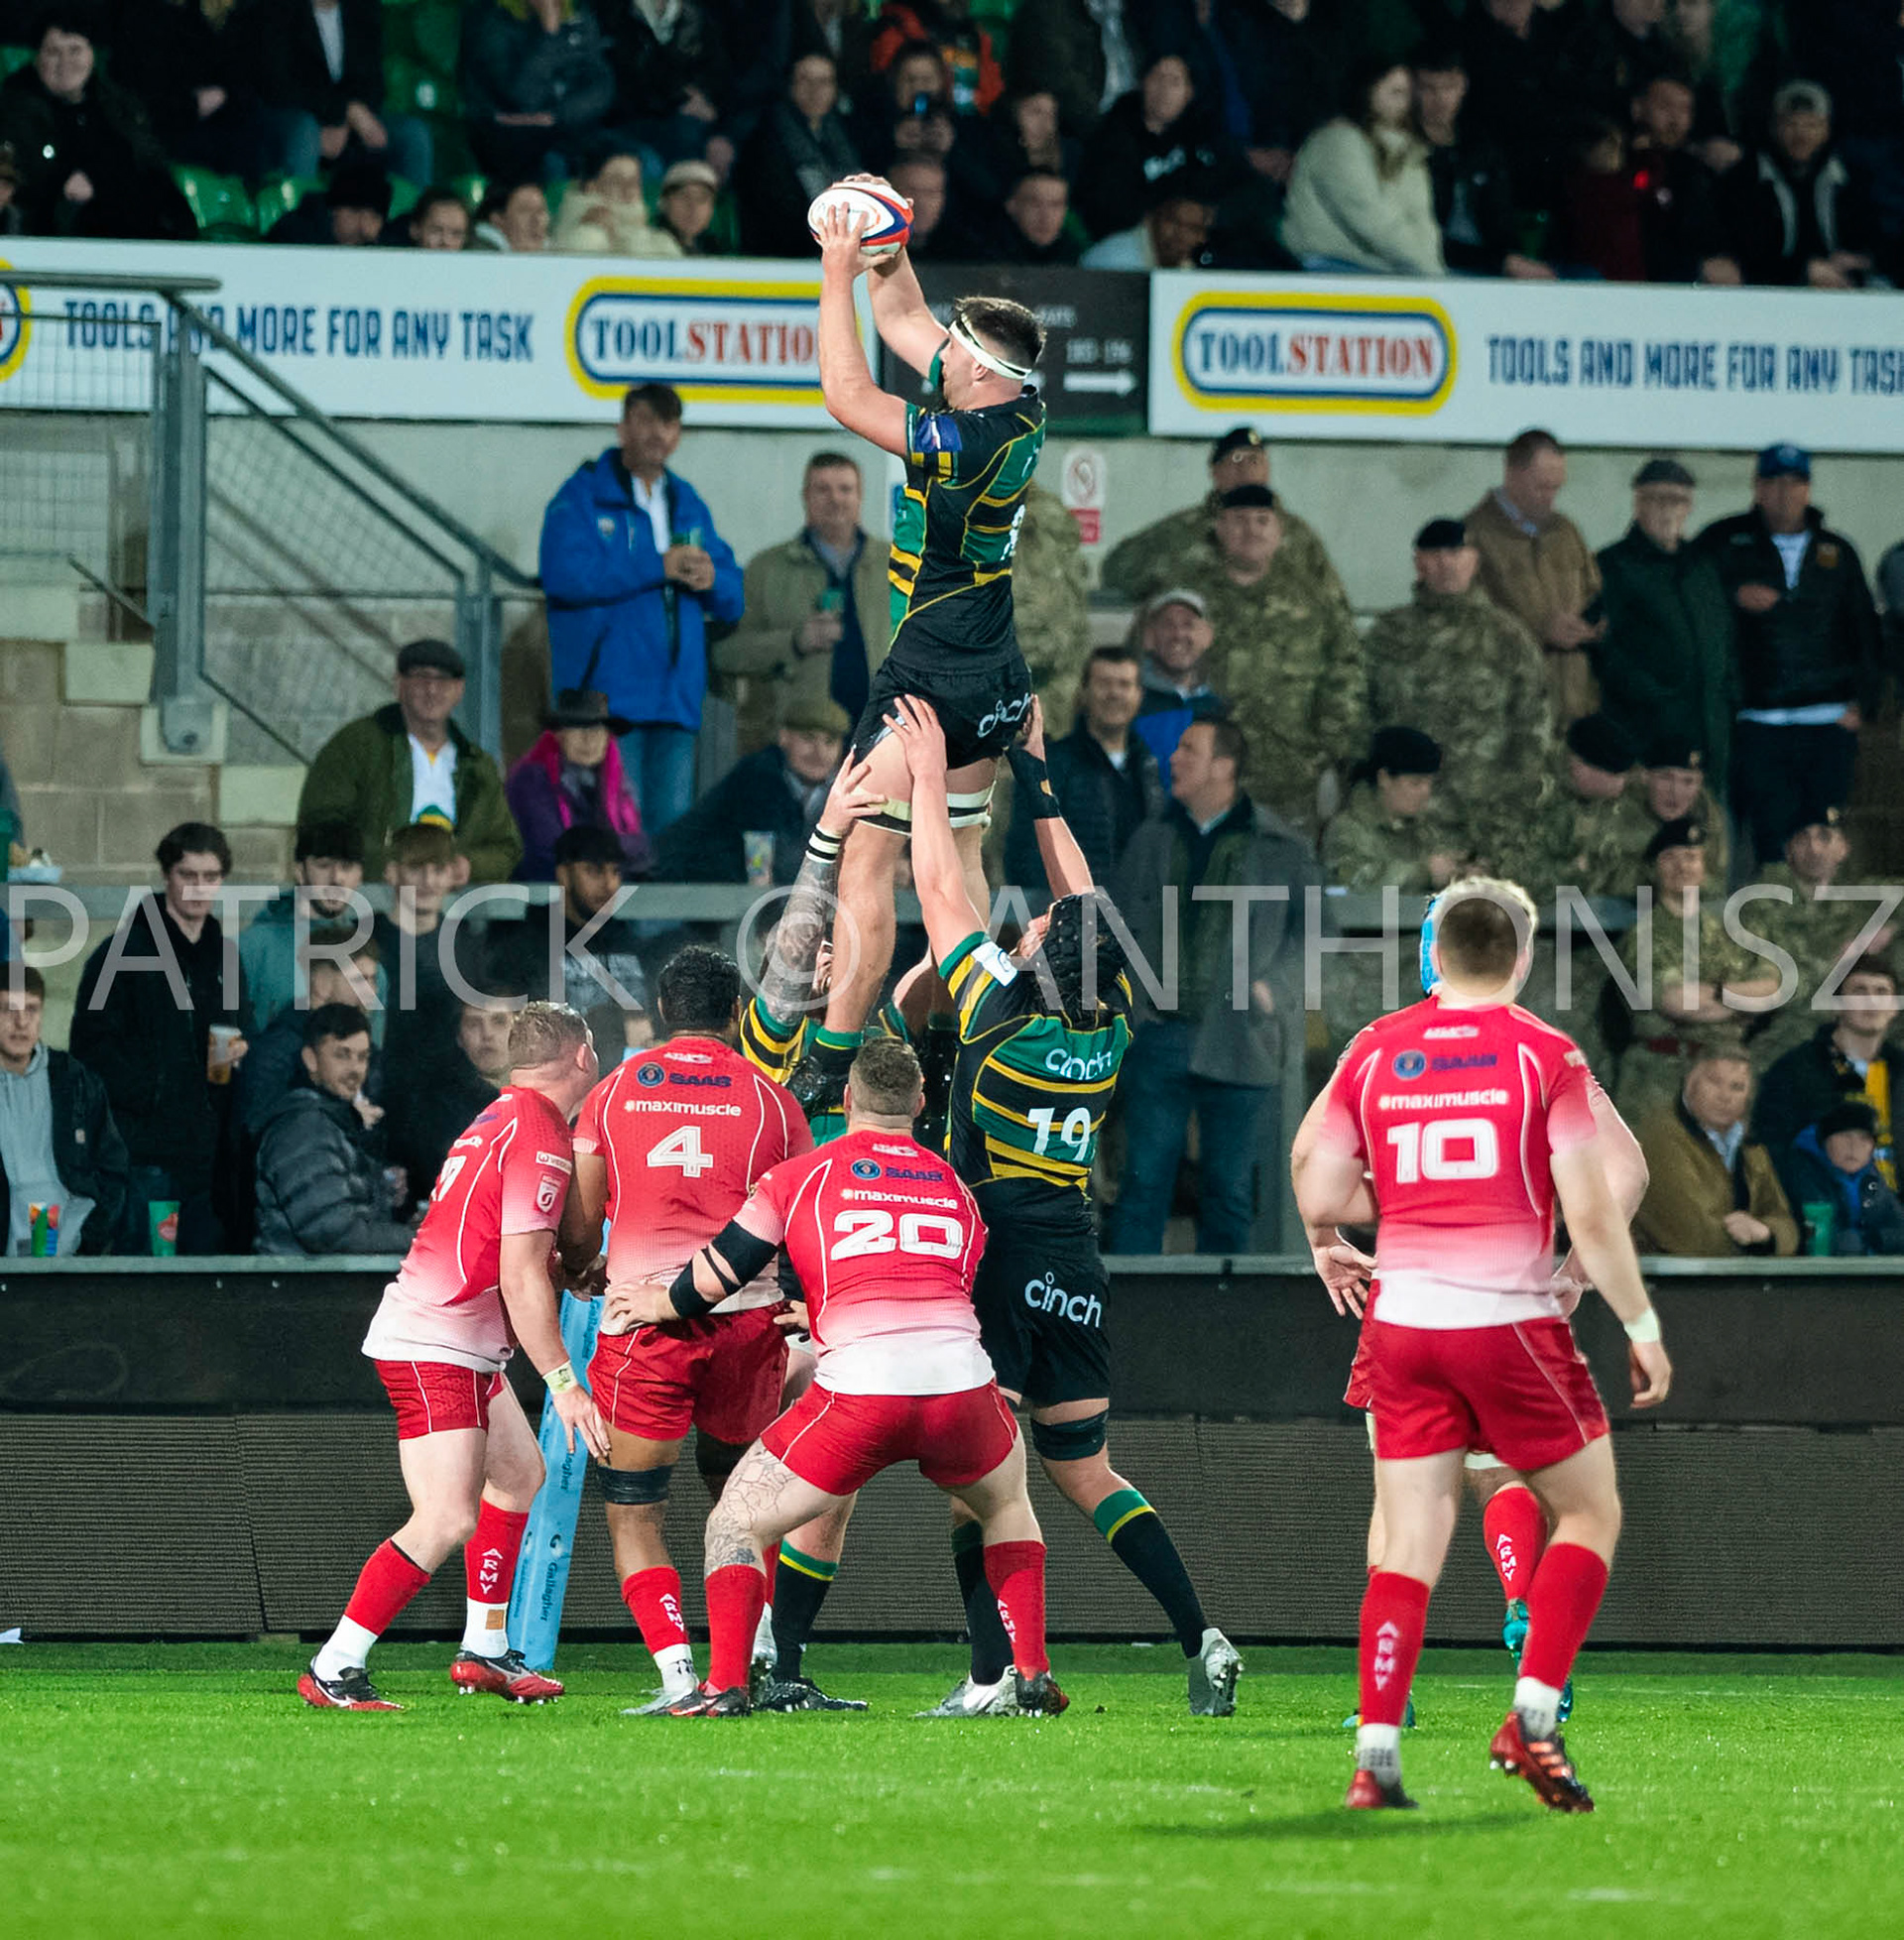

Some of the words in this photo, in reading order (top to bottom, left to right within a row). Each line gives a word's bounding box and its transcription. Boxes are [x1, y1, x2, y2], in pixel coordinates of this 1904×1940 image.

[63, 300, 155, 349] TOOLS
[238, 304, 317, 356] MORE
[327, 306, 382, 358] FOR
[392, 309, 448, 360] ANY
[459, 310, 534, 363] TASK
[589, 317, 815, 365] TOOLSTATIO
[1195, 330, 1435, 378] TOOLSTATION
[1487, 334, 1569, 387] TOOLS
[1579, 339, 1633, 389] AND
[1644, 342, 1717, 392] MORE
[1728, 344, 1776, 393] FOR
[1786, 345, 1838, 394] ANY
[647, 1125, 714, 1178] 4
[1026, 1107, 1092, 1162] 19
[1386, 1118, 1500, 1184] 10
[830, 1209, 964, 1261] 20
[1024, 1272, 1102, 1328] cinch
[479, 1547, 503, 1595] ARMY
[1496, 1532, 1518, 1581] ARMY
[539, 1562, 558, 1622] Gallagher
[658, 1592, 685, 1633] ARMY
[998, 1598, 1016, 1643] ARMY
[1372, 1621, 1400, 1691] ARMY
